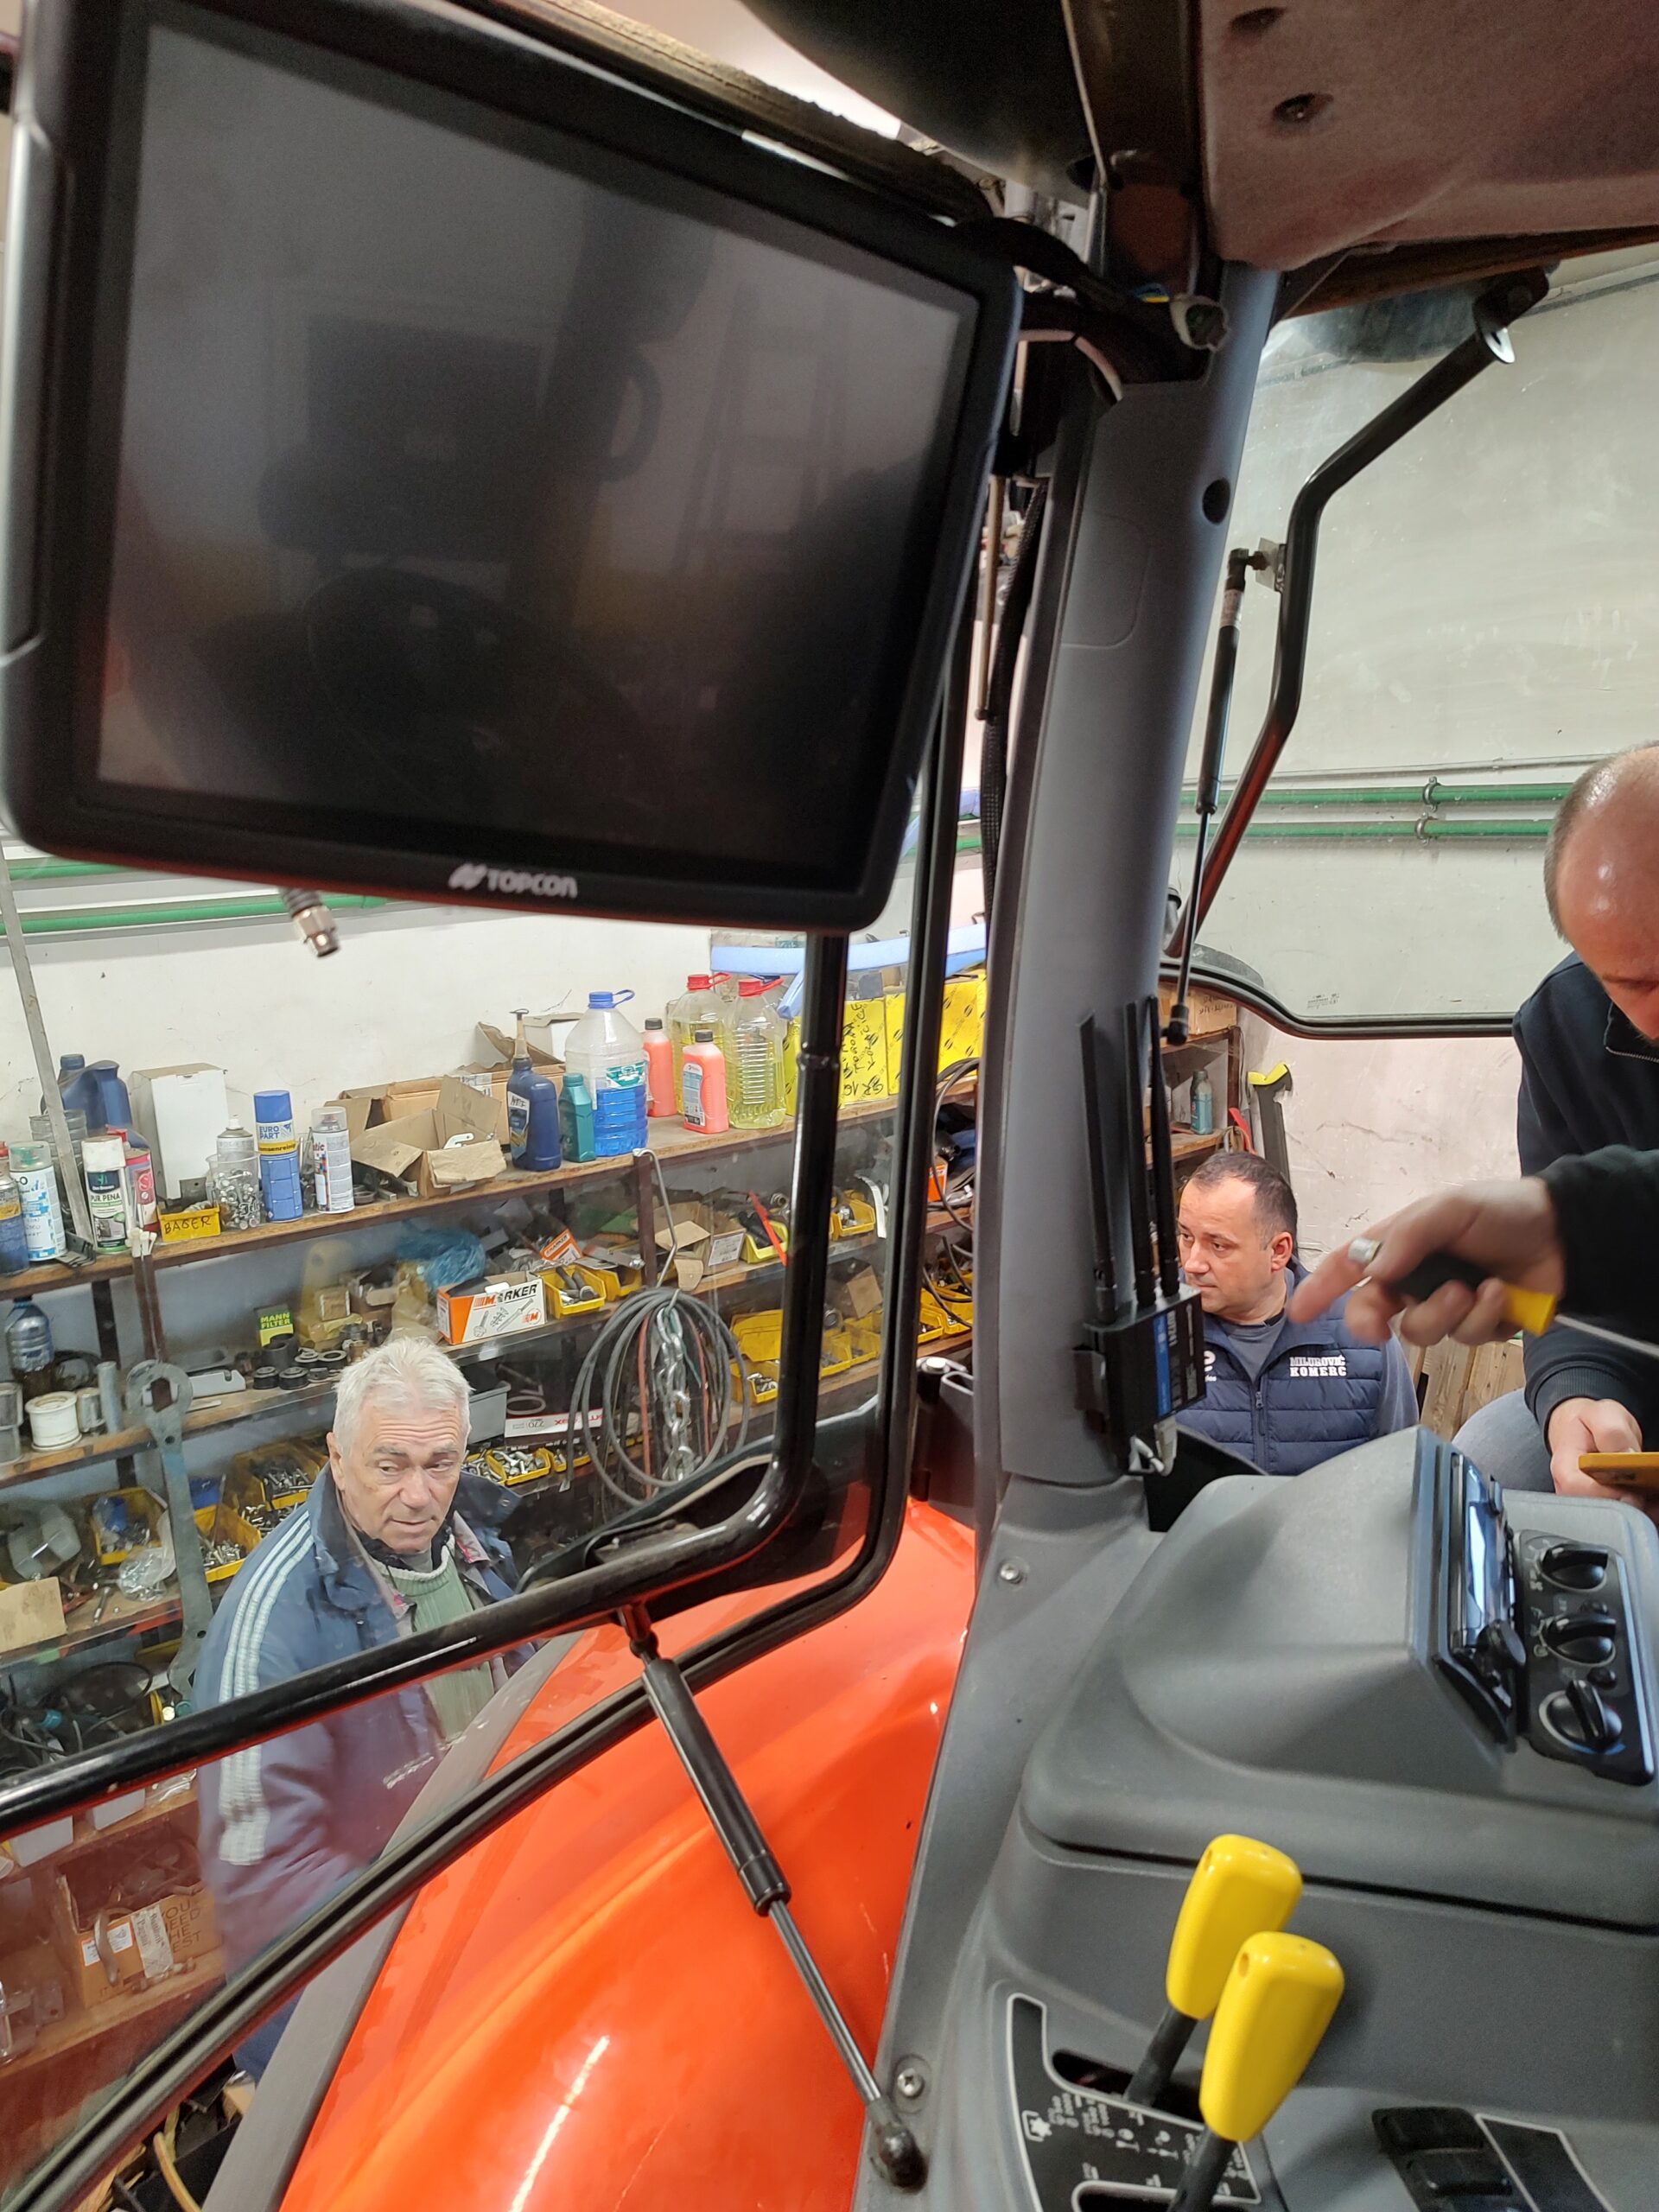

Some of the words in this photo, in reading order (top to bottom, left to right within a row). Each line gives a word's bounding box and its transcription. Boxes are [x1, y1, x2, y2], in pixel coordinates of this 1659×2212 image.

[486, 868, 578, 899] TOPCON
[261, 1312, 290, 1323] MANN
[261, 1319, 290, 1329] FILTER
[1289, 1366, 1347, 1376] KOMERC
